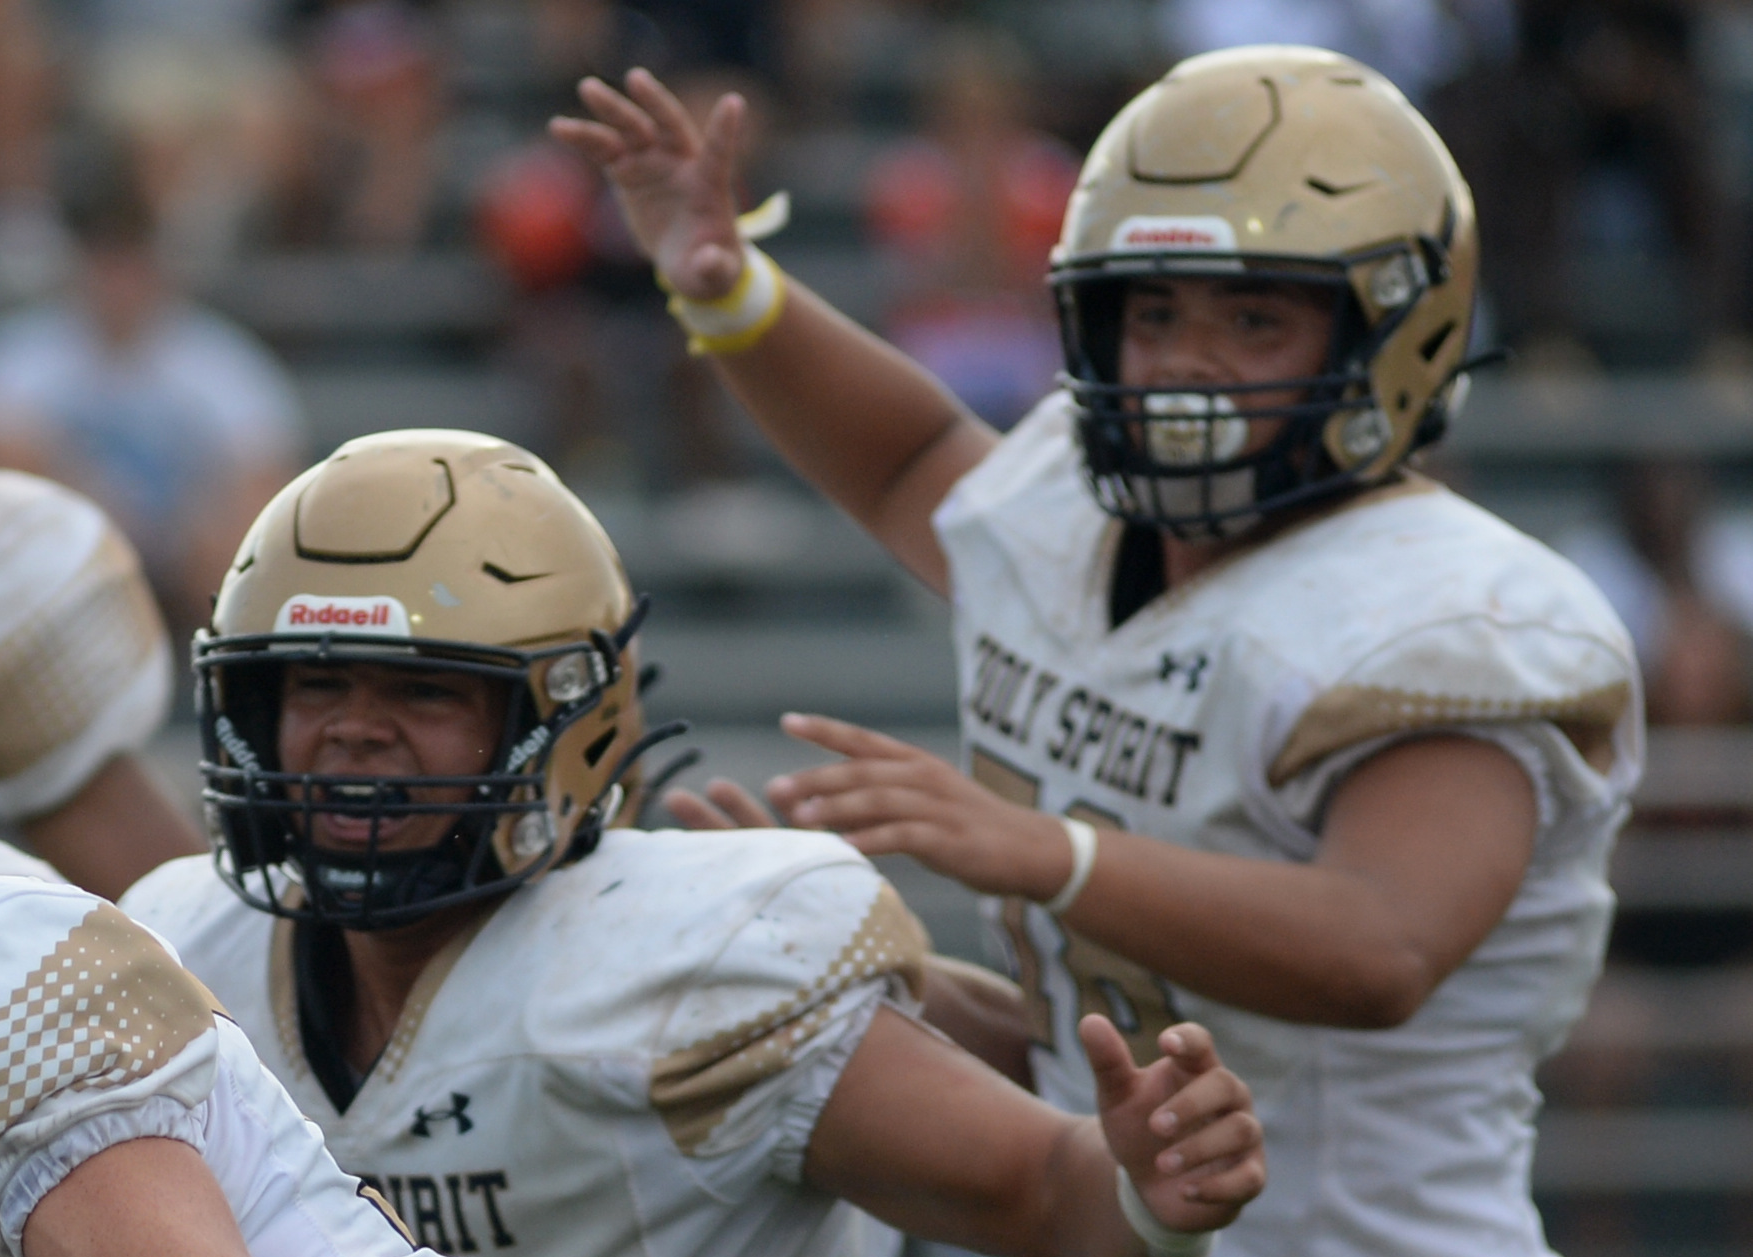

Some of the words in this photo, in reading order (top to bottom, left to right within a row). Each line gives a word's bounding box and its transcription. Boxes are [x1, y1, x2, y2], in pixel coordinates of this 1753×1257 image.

[289, 603, 389, 626] Riddell
[1049, 686, 1202, 807] SPIRIT
[355, 1171, 515, 1252] IRIT
